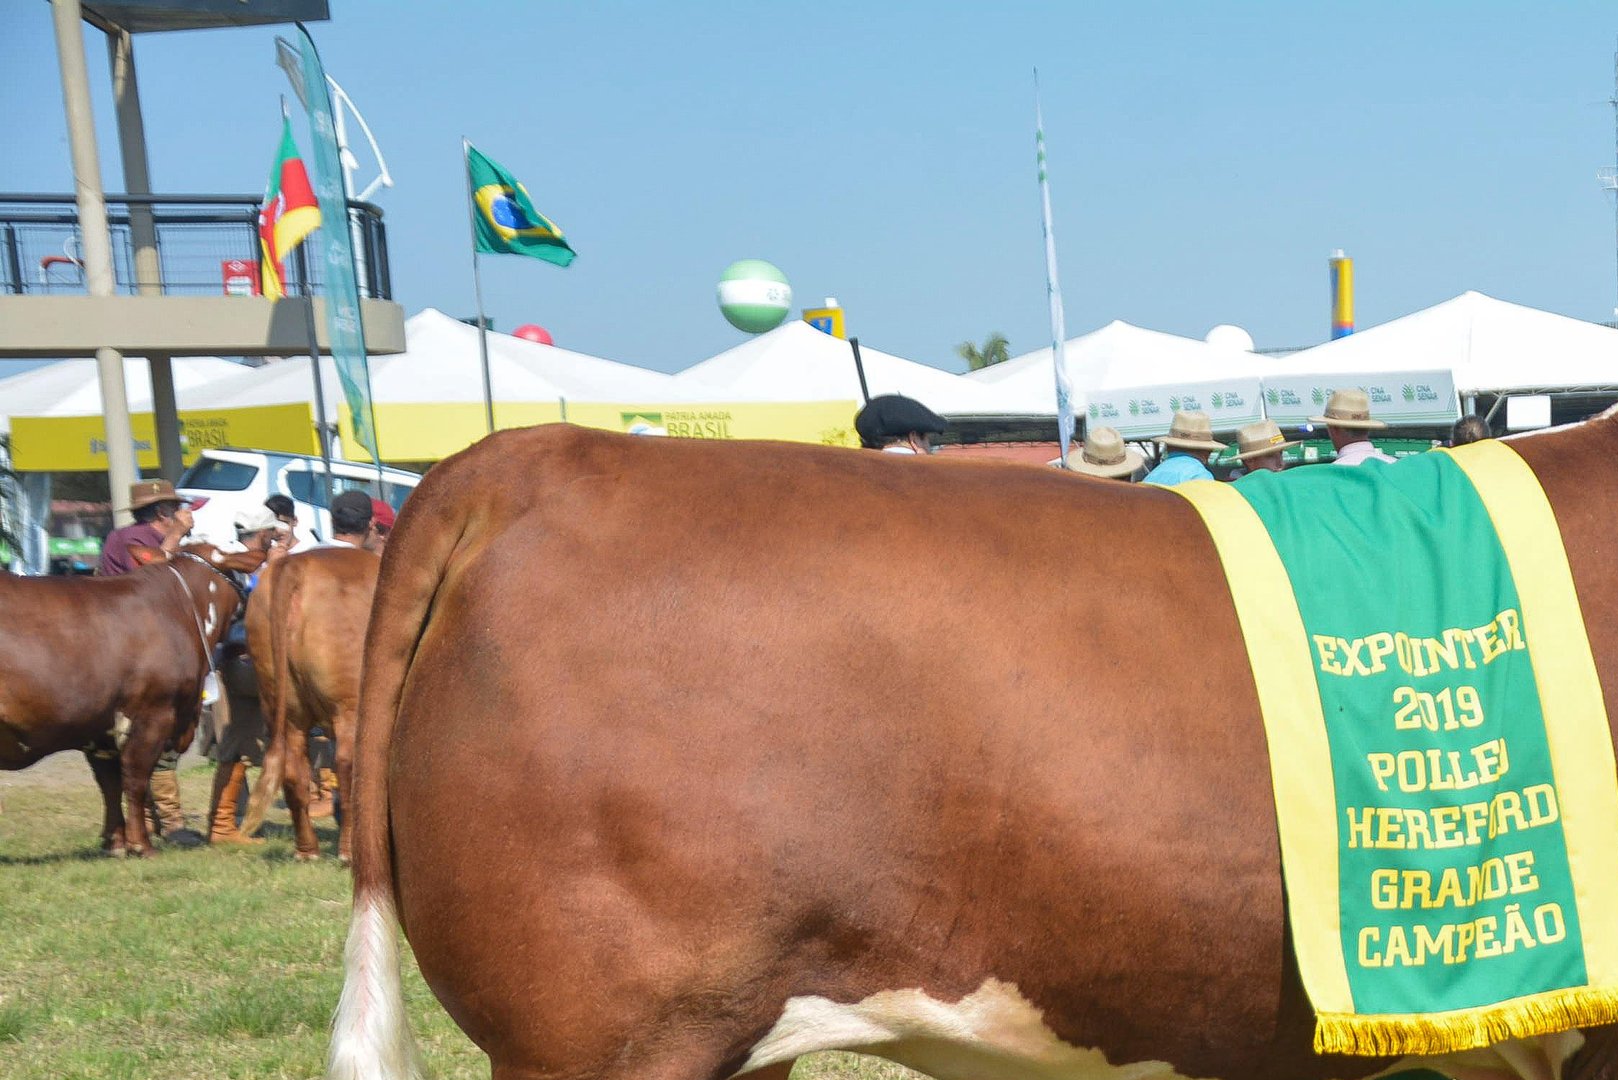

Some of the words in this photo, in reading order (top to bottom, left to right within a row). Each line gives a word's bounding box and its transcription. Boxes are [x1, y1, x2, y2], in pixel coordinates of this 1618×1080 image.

[667, 421, 733, 439] BRASIL
[1313, 608, 1526, 677] EXPOINTER
[1393, 686, 1485, 731] 2019
[1371, 850, 1540, 910] GRANDE
[1358, 902, 1567, 967] CAMPEÃO
